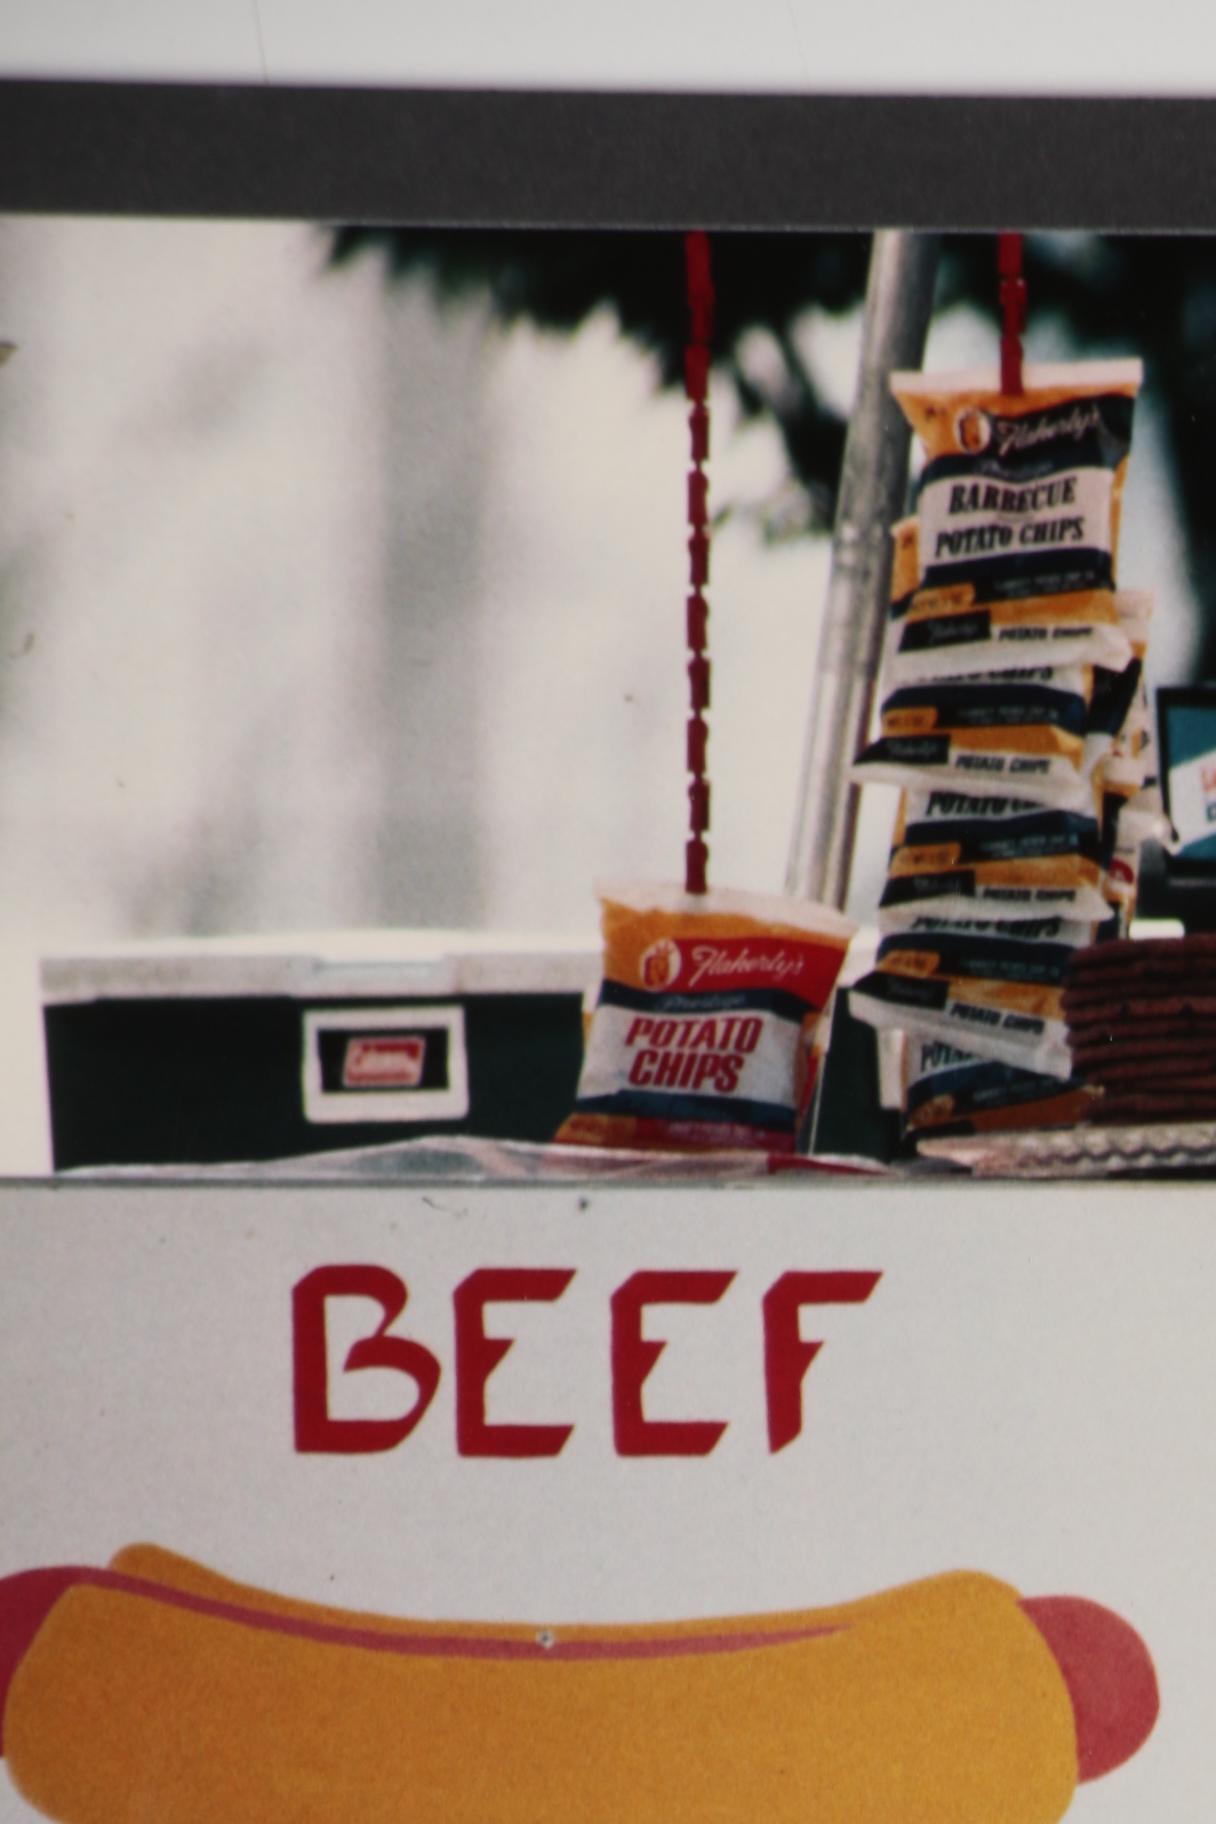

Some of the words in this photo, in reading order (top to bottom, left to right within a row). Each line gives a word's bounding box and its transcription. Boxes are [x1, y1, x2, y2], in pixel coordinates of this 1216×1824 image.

[949, 476, 1078, 515] BARBECUE
[935, 525, 1013, 559] POTATO
[1018, 517, 1085, 544] CHIPS
[624, 1014, 765, 1054] POTATO
[627, 1049, 745, 1093] CHIPS
[291, 1264, 883, 1457] BEEF
